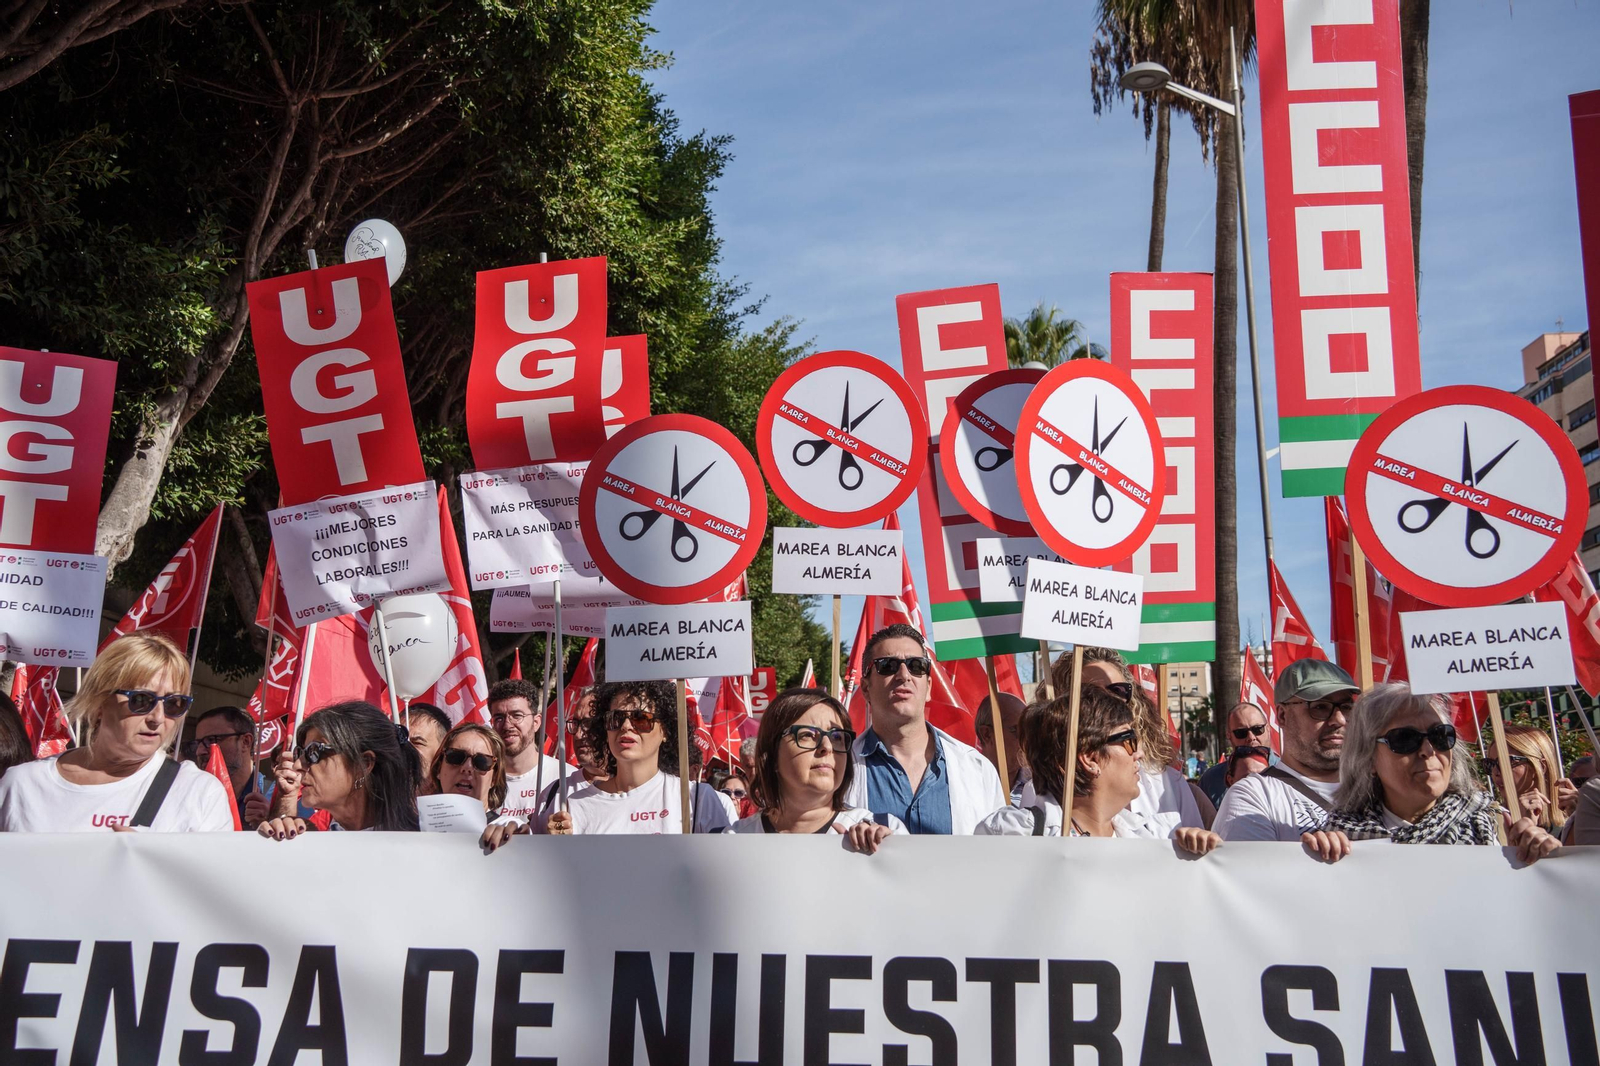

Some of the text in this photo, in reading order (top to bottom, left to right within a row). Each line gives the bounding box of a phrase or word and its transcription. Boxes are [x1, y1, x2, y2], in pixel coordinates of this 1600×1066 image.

[1282, 0, 1396, 400] CCOO
[496, 273, 579, 461] UGT
[279, 276, 386, 487] UGT
[967, 409, 996, 432] MAREA
[779, 403, 908, 476] MAREA BLANCA ALMERÍA
[0, 360, 84, 546] UGT
[1035, 420, 1151, 505] MAREA BLANCA ALMERÍA
[466, 479, 485, 489] UGT
[518, 473, 536, 483] UGT
[382, 494, 403, 505] UGT
[1373, 458, 1564, 534] MAREA BLANCA ALMERÍA
[329, 503, 348, 514] UGT
[490, 501, 515, 515] MÁS
[602, 475, 747, 541] MAREA BLANCA ALMERÍA
[273, 514, 293, 526] UGT
[473, 529, 503, 541] PARA
[505, 527, 520, 538] LA
[523, 520, 573, 534] SANIDAD
[311, 536, 408, 562] CONDICIONES
[777, 542, 897, 557] MAREA BLANCA
[46, 558, 70, 568] UGT
[315, 559, 409, 586] LABORALES!!!
[529, 565, 550, 576] UGT
[802, 563, 872, 580] ALMERÍA
[475, 571, 495, 582] UGT
[1030, 578, 1137, 606] MAREA BLANCA
[22, 602, 94, 619] CALIDAD!!!
[295, 606, 315, 619] UGT
[1052, 609, 1113, 630] ALMERÍA
[611, 621, 670, 637] MAREA
[678, 618, 745, 635] BLANCA
[1411, 626, 1562, 649] MAREA BLANCA
[33, 648, 57, 658] UGT
[640, 641, 718, 662] ALMERÍA
[1447, 651, 1534, 675] ALMERÍA
[91, 813, 130, 828] UGT
[630, 811, 657, 822] UGT
[400, 947, 566, 1066] DE
[607, 950, 1214, 1066] NUESTRA
[1260, 964, 1600, 1066] SANI
